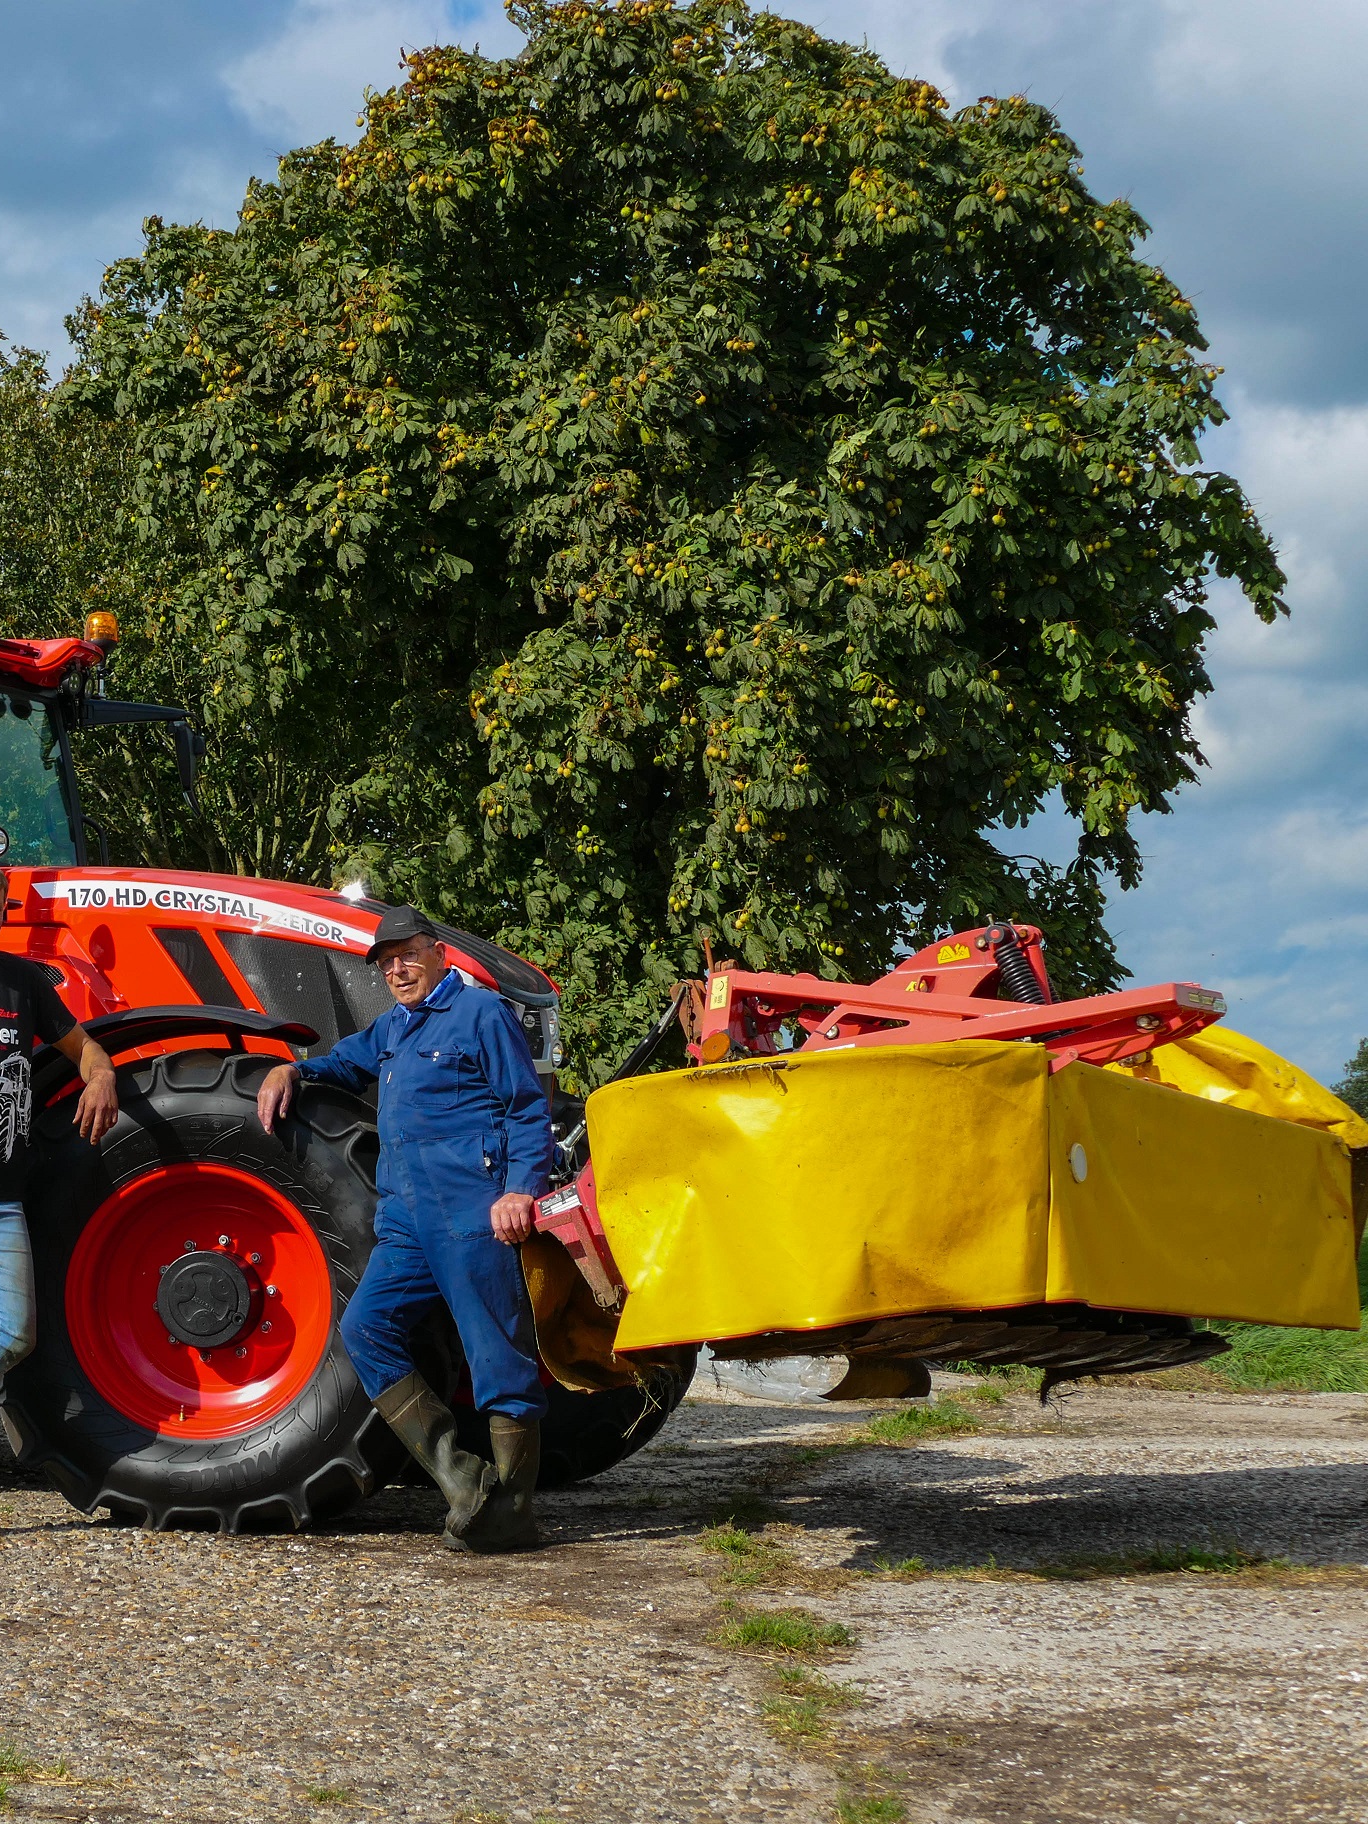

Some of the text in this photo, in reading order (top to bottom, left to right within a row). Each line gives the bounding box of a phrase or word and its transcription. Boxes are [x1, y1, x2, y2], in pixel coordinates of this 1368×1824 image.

[68, 888, 343, 943] 170 HD CRYSTAL ZETOR
